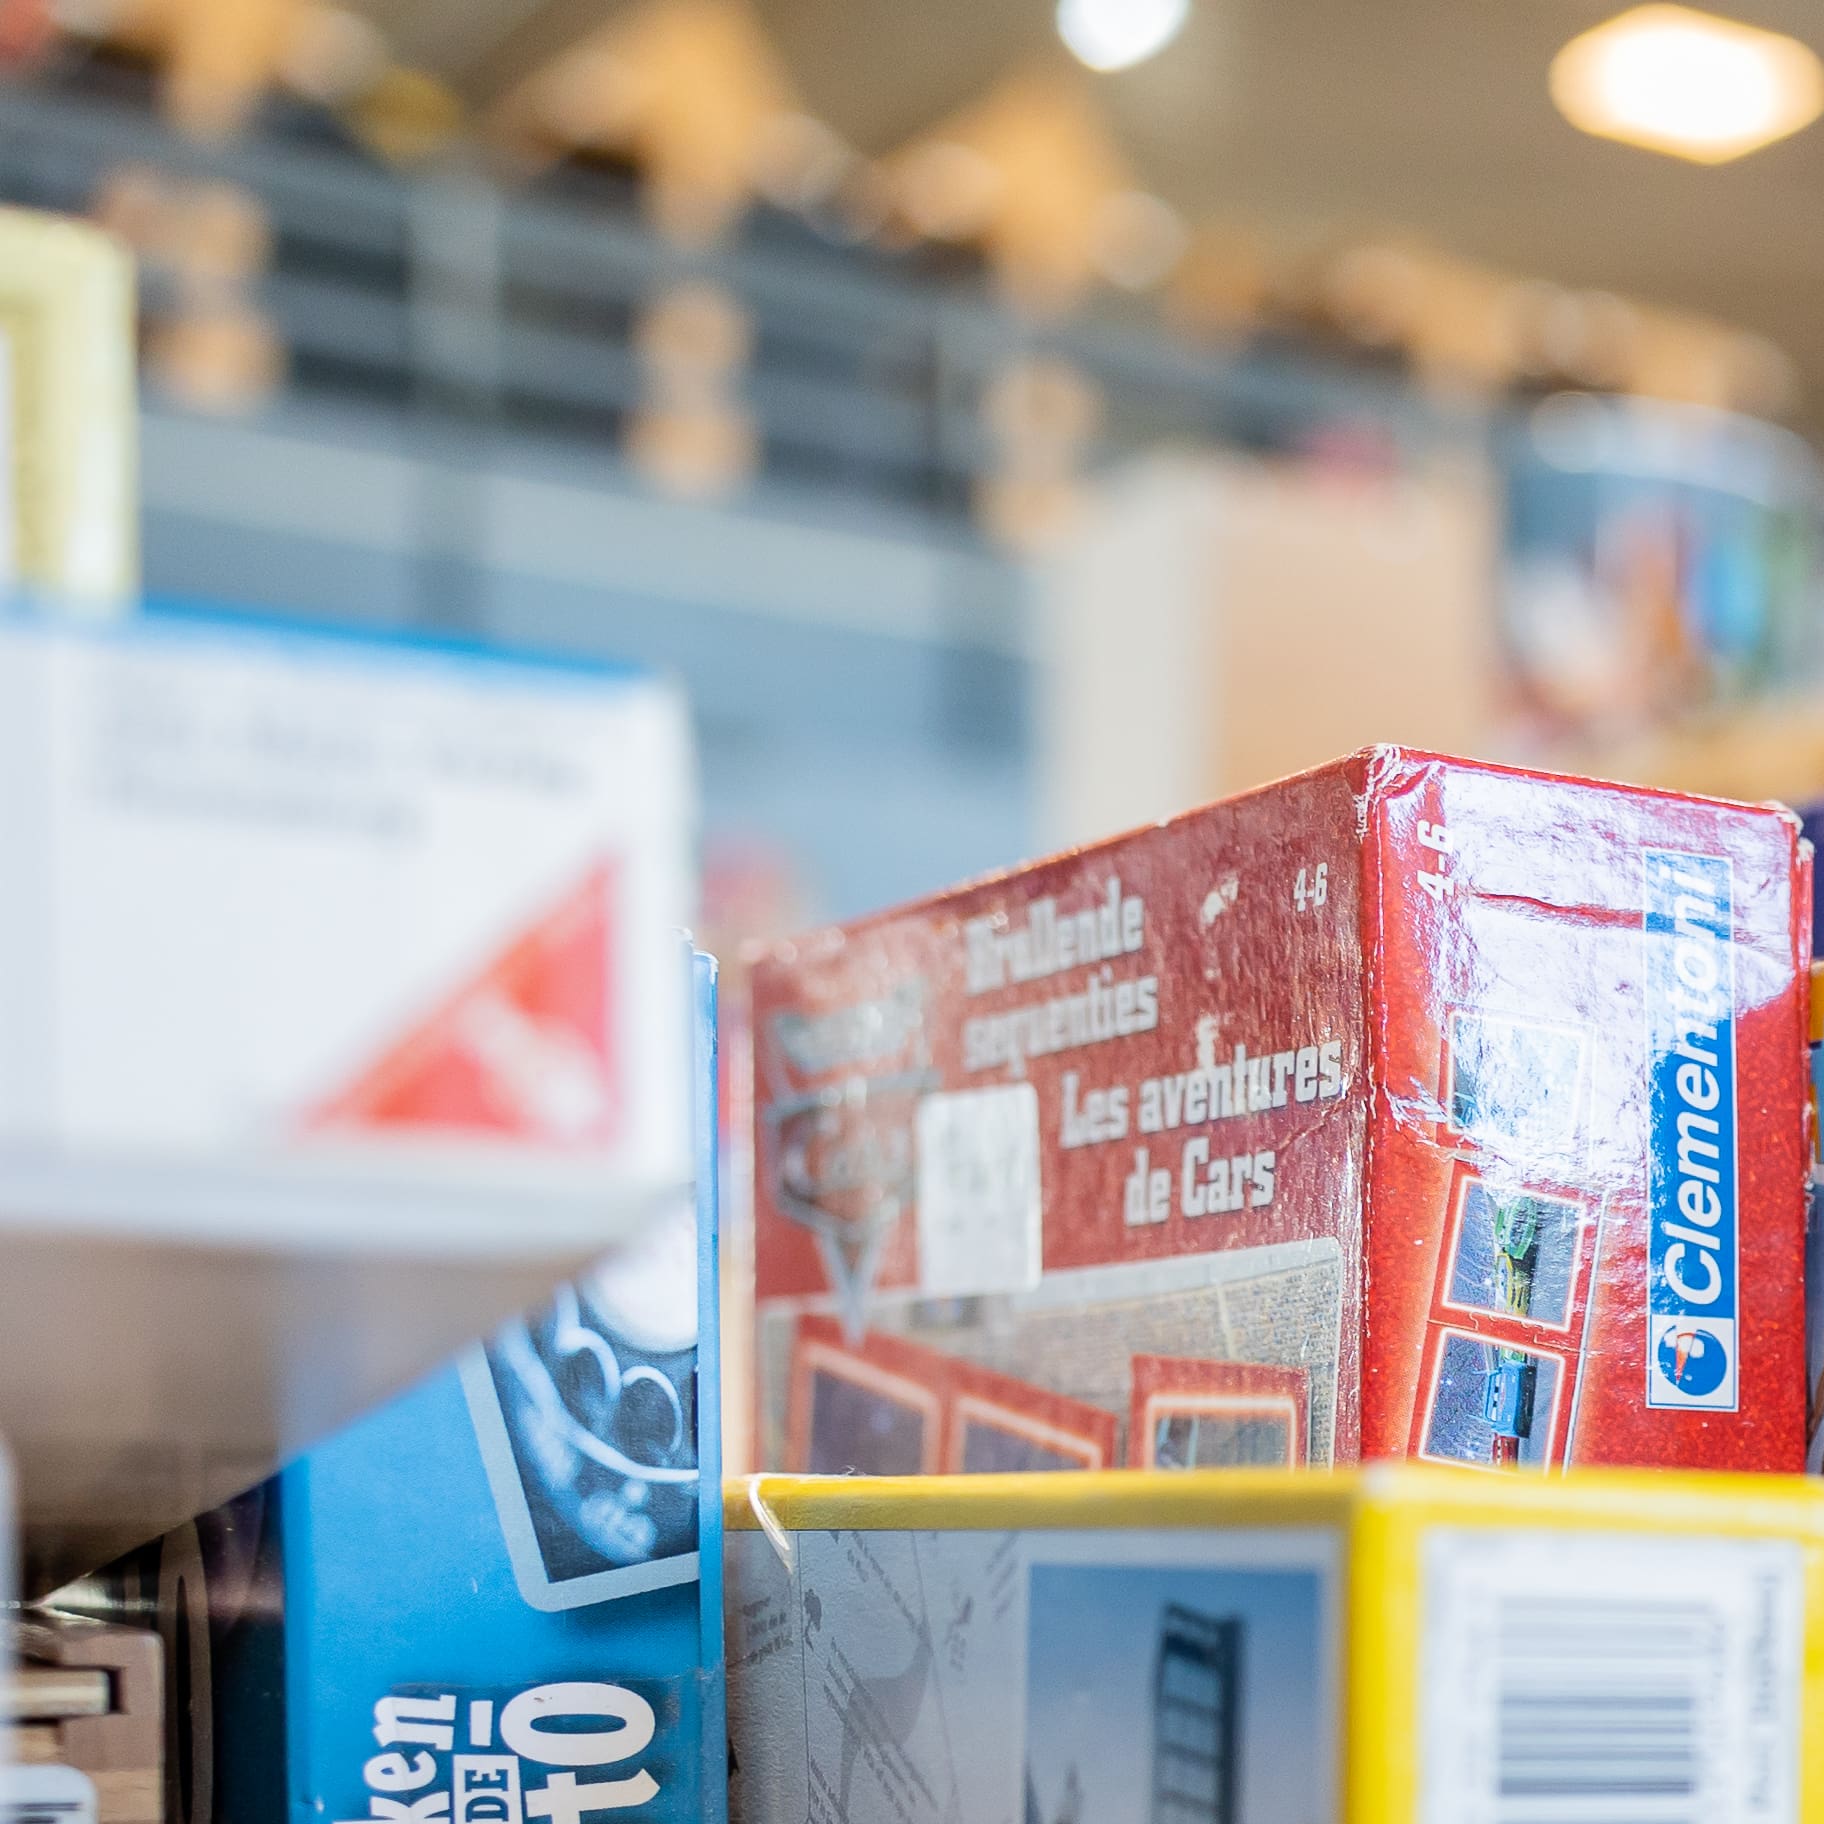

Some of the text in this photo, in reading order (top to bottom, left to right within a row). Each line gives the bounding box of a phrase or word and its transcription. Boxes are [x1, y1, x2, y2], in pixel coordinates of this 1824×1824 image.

[1293, 863, 1328, 911] 4-6
[1417, 820, 1456, 899] 4-6
[1059, 1041, 1344, 1150] Les aventures
[1662, 868, 1723, 1305] Clementoni
[1124, 1137, 1275, 1227] de Cars
[465, 1767, 509, 1823] DE
